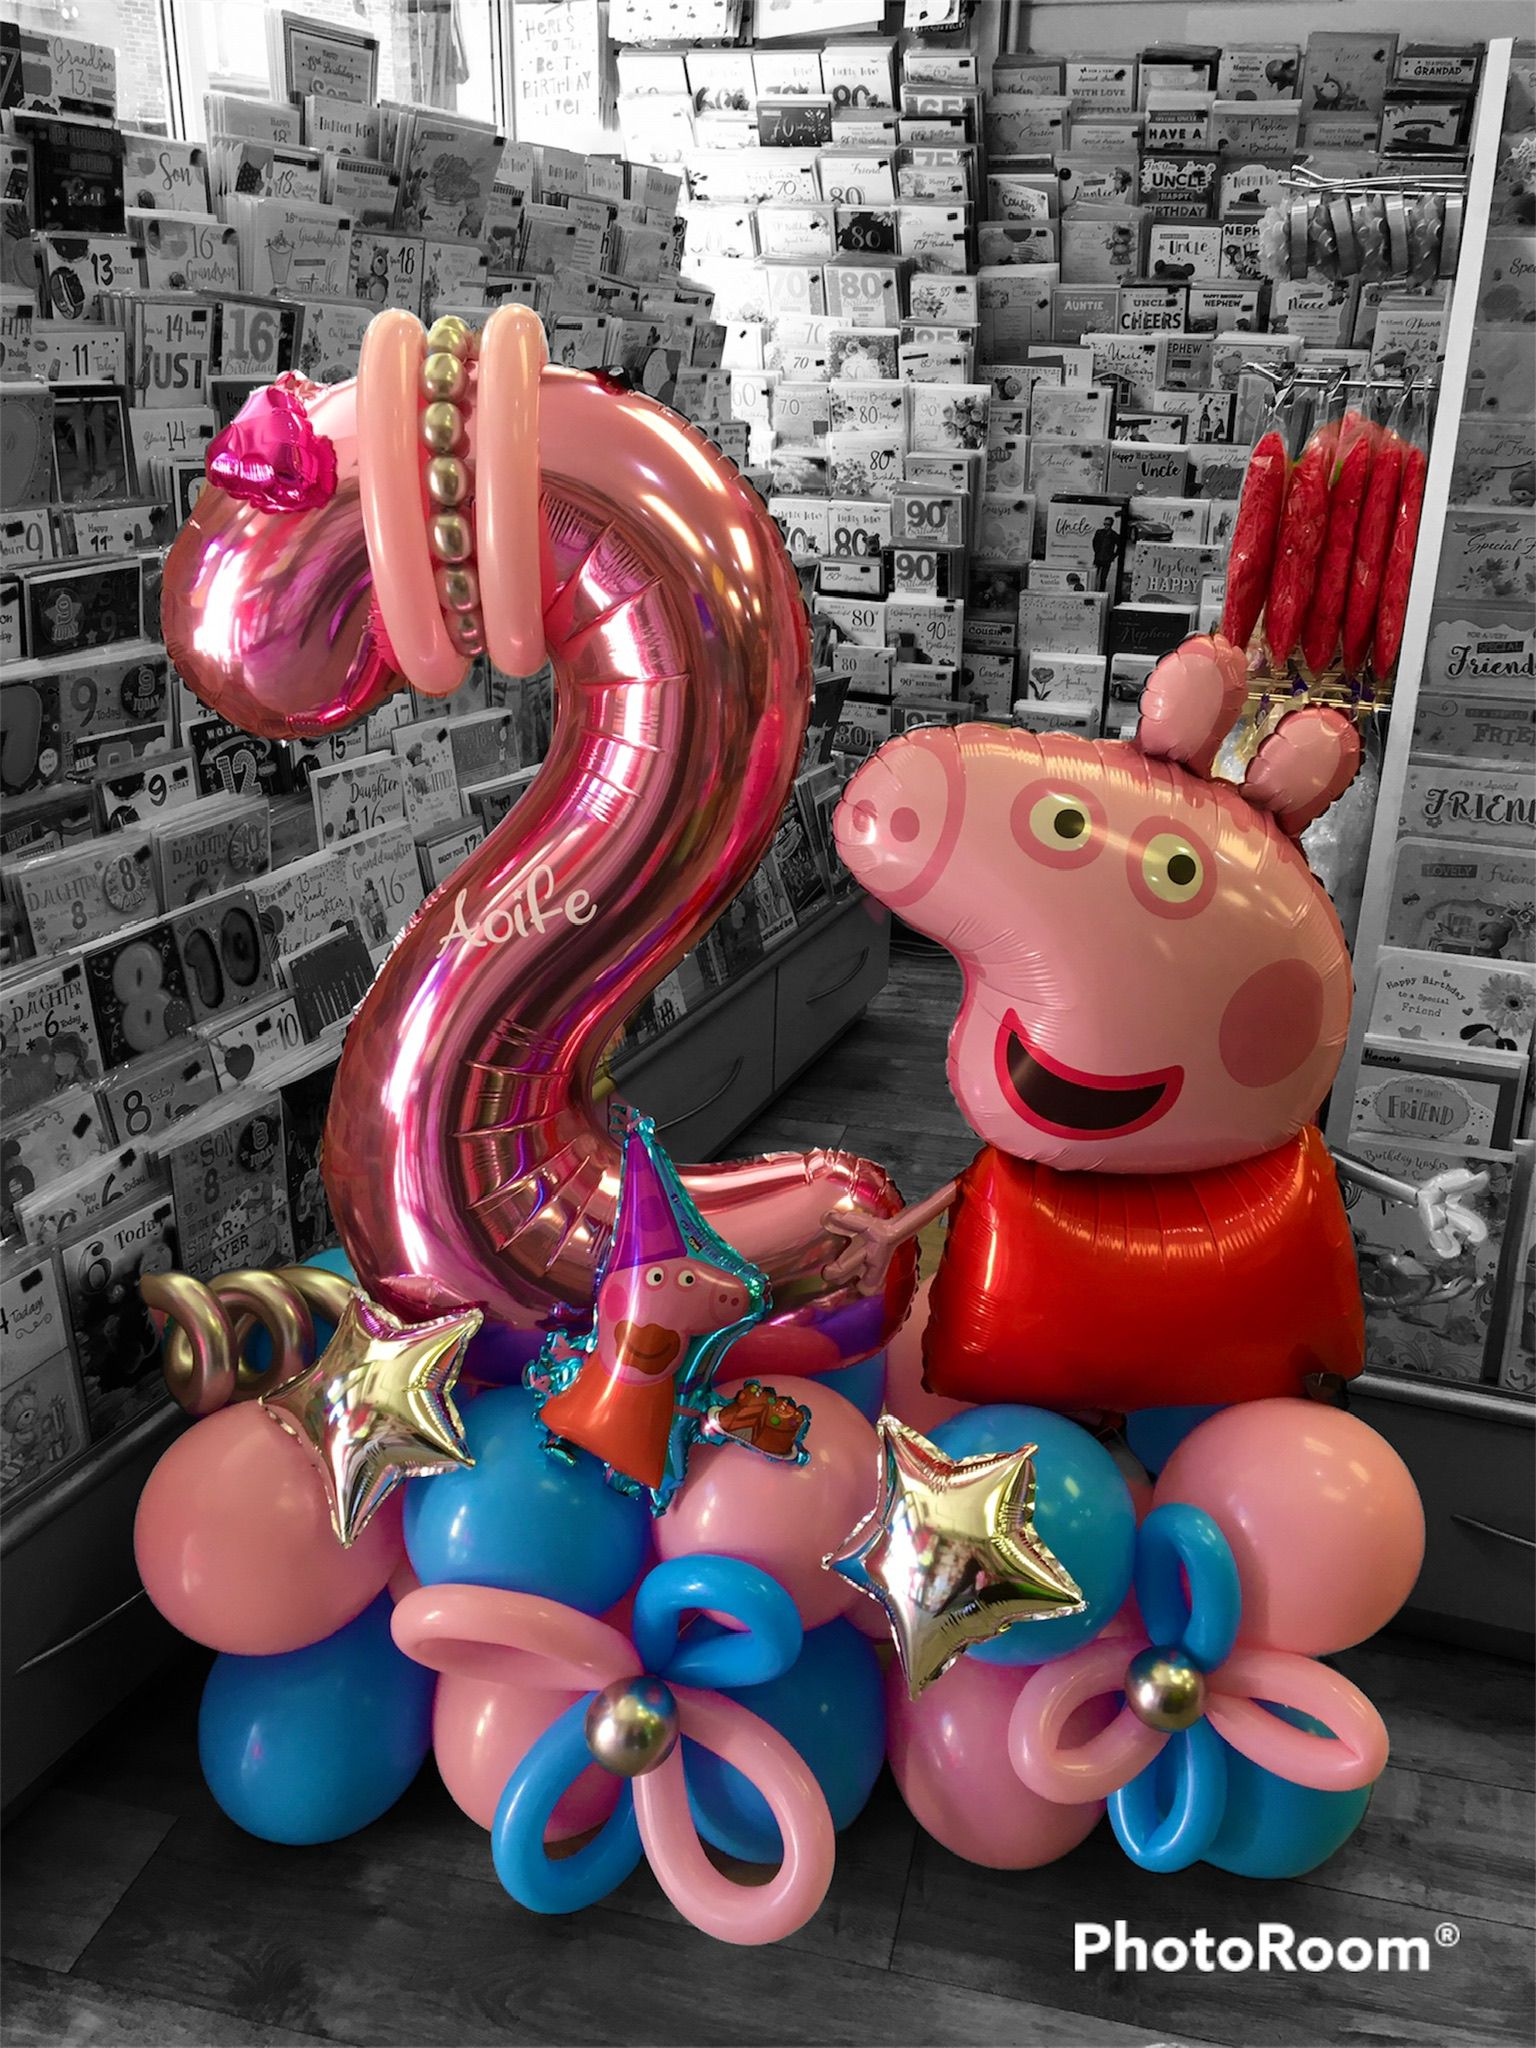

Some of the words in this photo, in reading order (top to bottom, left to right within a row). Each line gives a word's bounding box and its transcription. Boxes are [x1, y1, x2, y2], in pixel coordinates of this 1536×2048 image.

[67, 69, 87, 96] 13
[1414, 65, 1462, 77] GRANDAD
[1072, 88, 1098, 96] WITH
[1100, 88, 1126, 97] LOVE
[1149, 128, 1187, 140] HAVE
[1191, 128, 1202, 139] A
[1250, 117, 1289, 133] Nephew
[159, 152, 191, 190] Son
[1152, 172, 1207, 188] UNCLE
[775, 180, 797, 196] 70
[1002, 195, 1037, 214] Cousin
[192, 227, 213, 260] 16
[851, 226, 881, 249] 80
[91, 253, 113, 286] 13
[398, 247, 415, 275] 18
[841, 271, 882, 299] 80
[1064, 300, 1104, 311] AUNTIE
[1133, 299, 1170, 308] UNCL
[1205, 300, 1241, 308] NEPHEW
[1288, 297, 1327, 311] Niece
[166, 313, 183, 342] 14
[1121, 312, 1182, 330] CHEERS
[1405, 316, 1442, 330] Nanna
[229, 308, 274, 363] 16
[72, 344, 89, 376] 11
[793, 357, 809, 370] 70
[780, 399, 800, 416] 70
[860, 406, 878, 425] 80
[167, 420, 186, 451] 14
[870, 451, 891, 471] 80
[1136, 452, 1172, 461] Birthday
[1142, 461, 1182, 478] Uncle
[906, 499, 947, 528] 90
[1055, 515, 1096, 536] Uncle
[834, 528, 869, 557] 80
[1467, 533, 1522, 554] Special
[895, 553, 936, 582] 90
[1151, 556, 1199, 578] Nephew
[1148, 577, 1200, 594] HAPPY
[926, 621, 946, 640] 90
[841, 657, 858, 672] 80
[70, 677, 98, 728] 9
[836, 724, 867, 746] 80
[329, 735, 346, 761] 15
[216, 749, 263, 796] 12
[150, 774, 167, 807] 9
[168, 779, 190, 792] TODAY
[351, 774, 399, 804] Daughter
[352, 841, 413, 879] Granddaughter
[1425, 865, 1473, 876] LOVELY
[380, 868, 405, 910] 16
[71, 900, 87, 930] 8
[436, 864, 598, 959] Aoife
[1386, 976, 1417, 991] Happy
[1422, 975, 1466, 1001] Birthday
[1418, 993, 1450, 1005] Special
[12, 980, 84, 1024] DAUGHTER
[1402, 1002, 1442, 1018] Friend
[45, 1010, 59, 1039] 6
[60, 1014, 81, 1031] Today
[277, 1011, 299, 1050] 10
[123, 1090, 151, 1137] 8
[1364, 1149, 1412, 1167] Birthday
[1415, 1157, 1449, 1171] Wishes
[122, 1173, 146, 1194] Today
[204, 1168, 220, 1205] 8
[184, 1220, 233, 1259] STAR
[187, 1235, 250, 1276] PLAYER
[78, 1241, 112, 1295] 6
[10, 1298, 45, 1324] Today!
